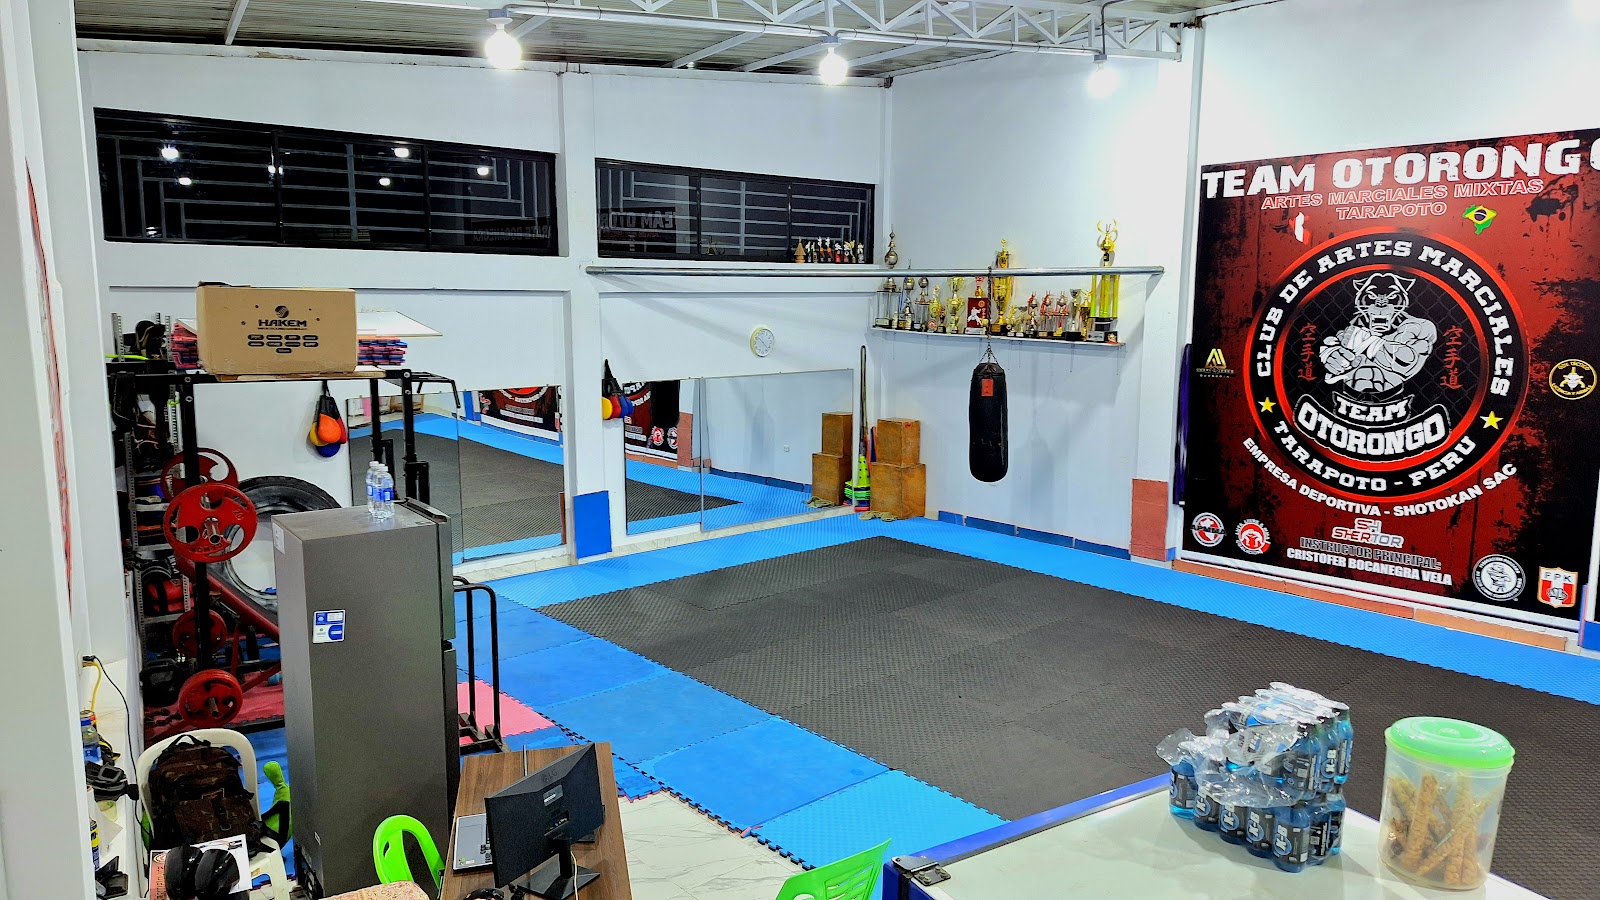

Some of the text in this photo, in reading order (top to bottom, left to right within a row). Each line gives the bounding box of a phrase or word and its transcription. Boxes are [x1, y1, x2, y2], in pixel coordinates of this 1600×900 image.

[1202, 163, 1316, 199] TEAM
[1261, 179, 1545, 210] ARTES MARCIALES MIXTAS
[1336, 201, 1447, 221] TARAPOTO
[258, 319, 307, 327] HAKEM
[1257, 240, 1515, 397] CLUB DE ARTES MARCIALES
[1297, 322, 1317, 381] 空手道
[1440, 325, 1463, 390] 空手道
[1336, 395, 1409, 422] TEAM
[1297, 401, 1446, 456] OTORONGO
[1274, 420, 1387, 491] TARAPOTO
[1408, 435, 1477, 487] PERU
[1242, 437, 1298, 490] EMPRESA
[1298, 484, 1382, 516] DEPORTIVA
[1393, 484, 1484, 517] SHOTOKAN
[1482, 463, 1518, 490] SAC
[1299, 537, 1373, 560] INSTRUCTOR
[1331, 526, 1404, 548] SHERTOR
[1286, 547, 1347, 568] CRISTOFER
[1348, 558, 1421, 581] BOCANEGRA
[1421, 570, 1453, 586] VELA
